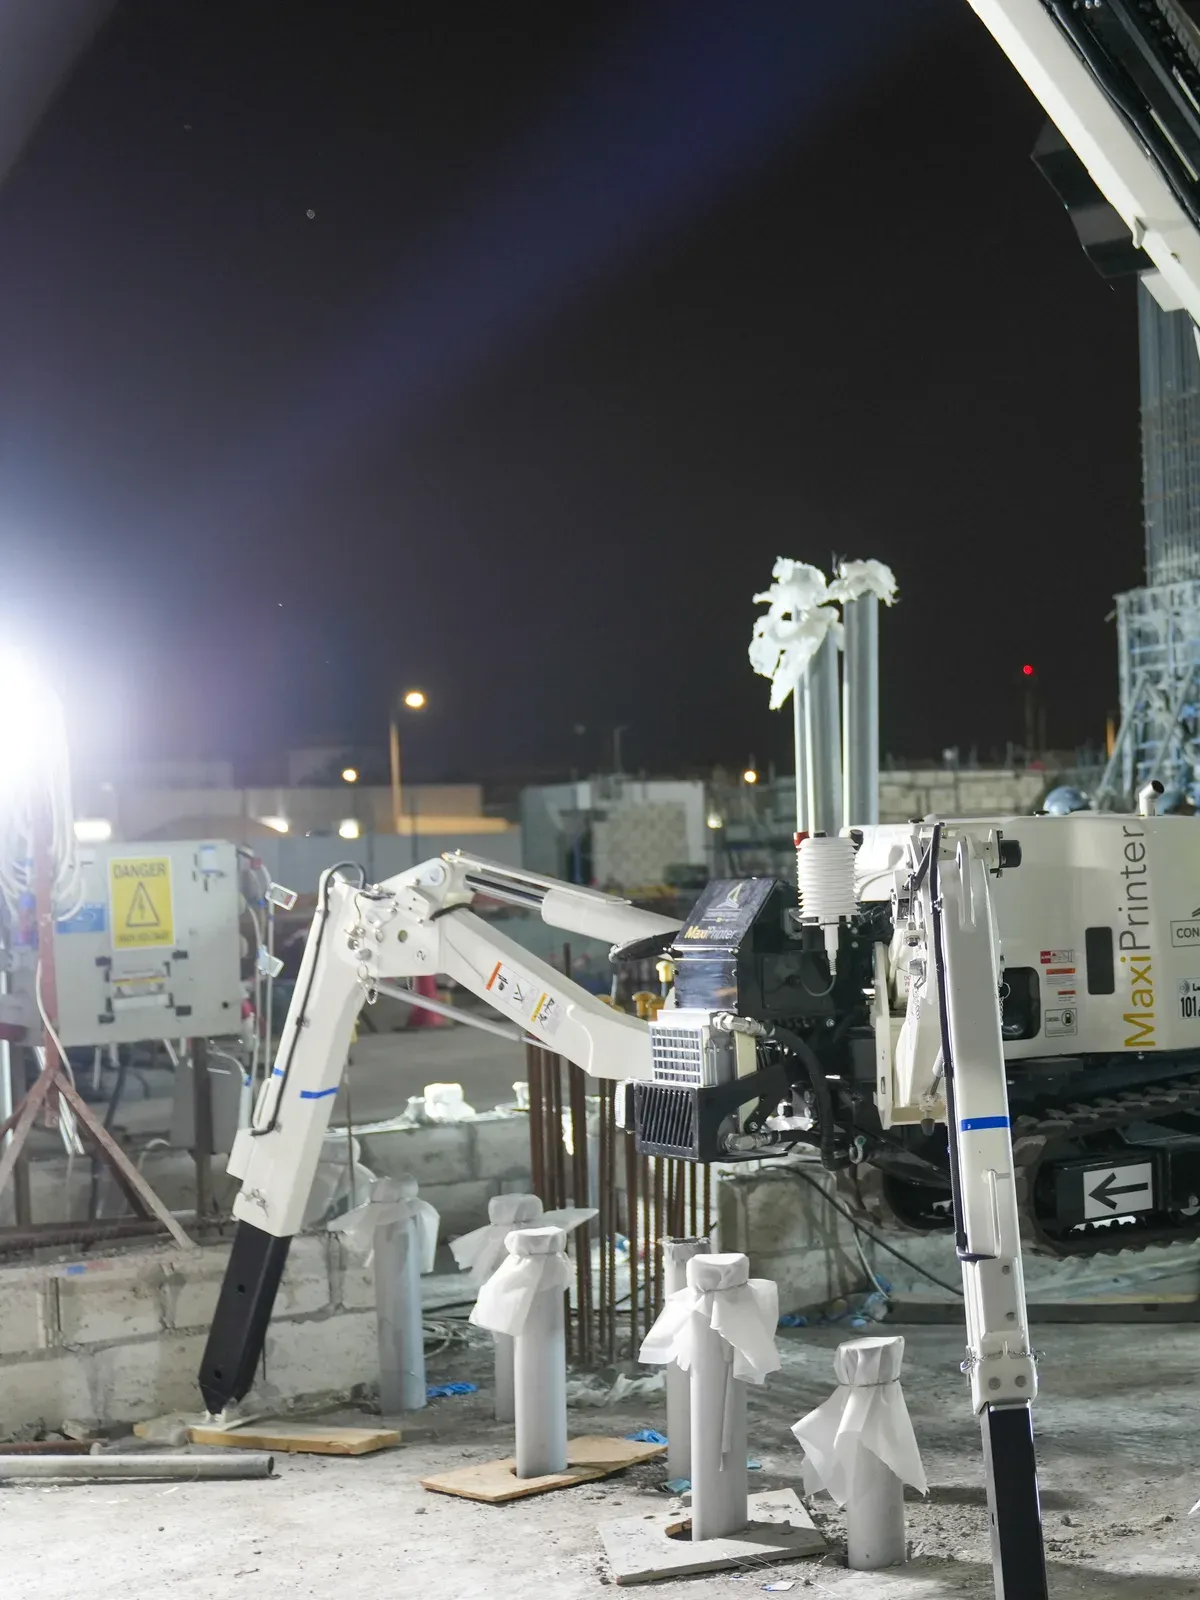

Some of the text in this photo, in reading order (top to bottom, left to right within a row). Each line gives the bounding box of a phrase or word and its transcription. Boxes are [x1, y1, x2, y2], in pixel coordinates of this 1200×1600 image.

[113, 862, 166, 879] DANGER
[684, 925, 738, 940] MaxiPrinter
[1119, 825, 1157, 1047] MaxiPrinter
[1180, 996, 1197, 1018] 101
